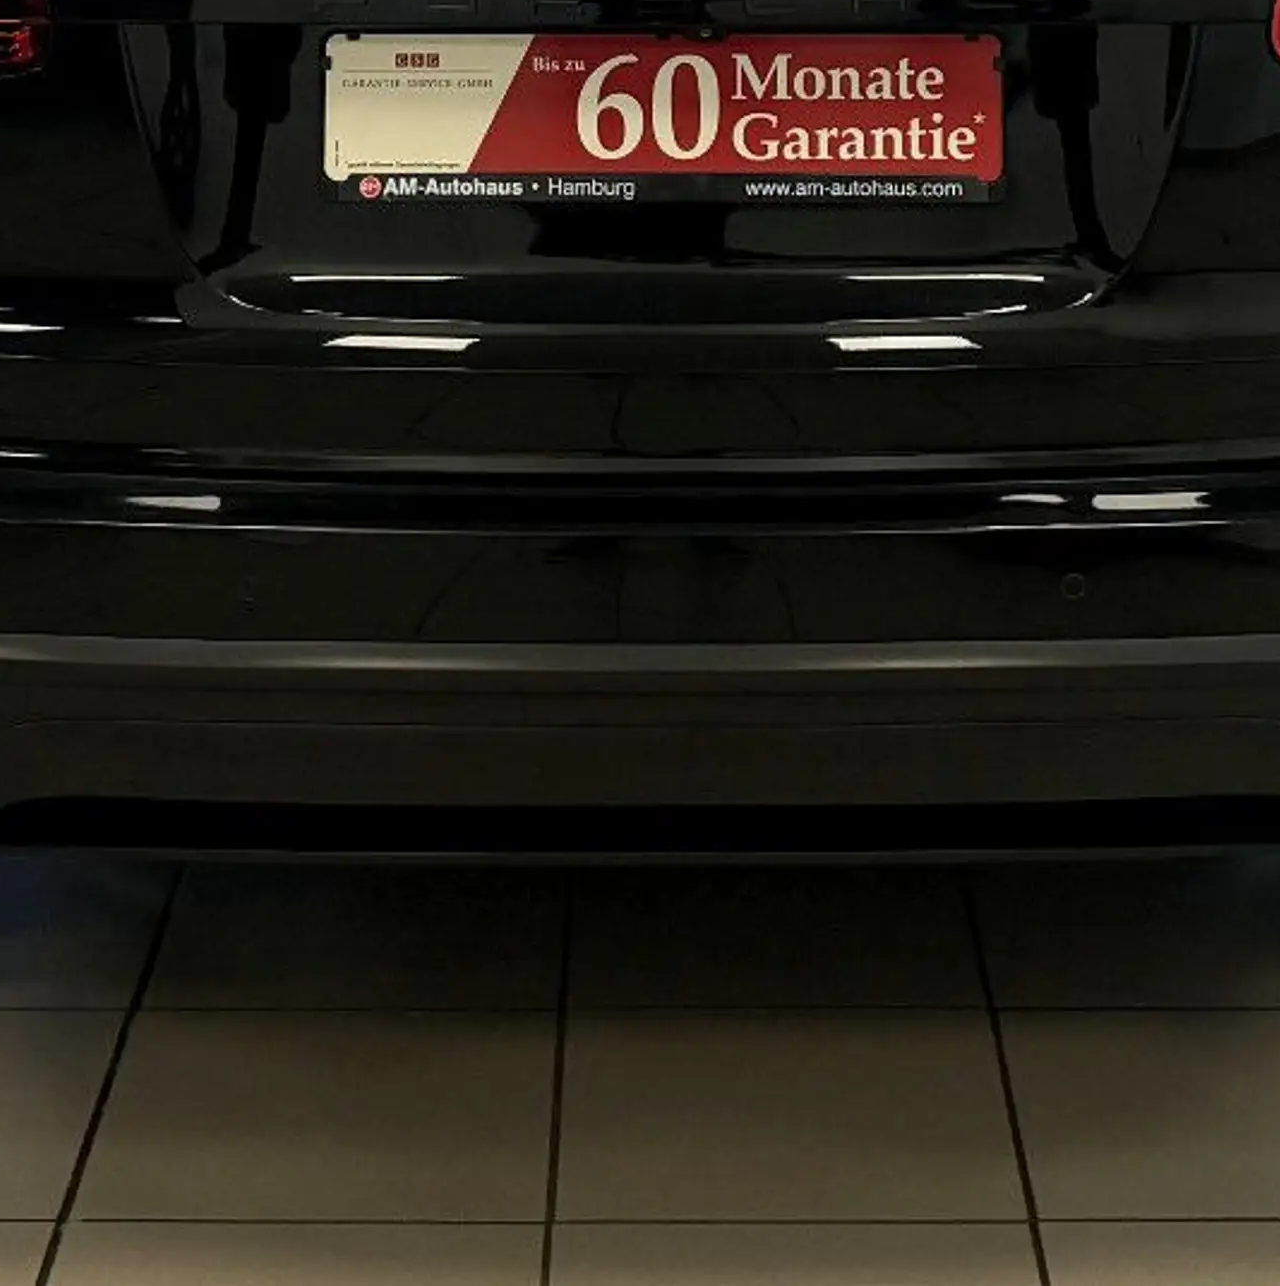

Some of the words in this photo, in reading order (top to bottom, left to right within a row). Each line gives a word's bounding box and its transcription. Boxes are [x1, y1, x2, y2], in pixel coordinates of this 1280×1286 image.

[532, 57, 561, 72] Bis
[563, 61, 586, 72] zu
[730, 53, 945, 101] Monate
[577, 53, 720, 160] 60
[383, 177, 523, 196] AM-Autohaus
[548, 178, 635, 198] Hamburg
[745, 181, 963, 197] www.am-autohaus.com
